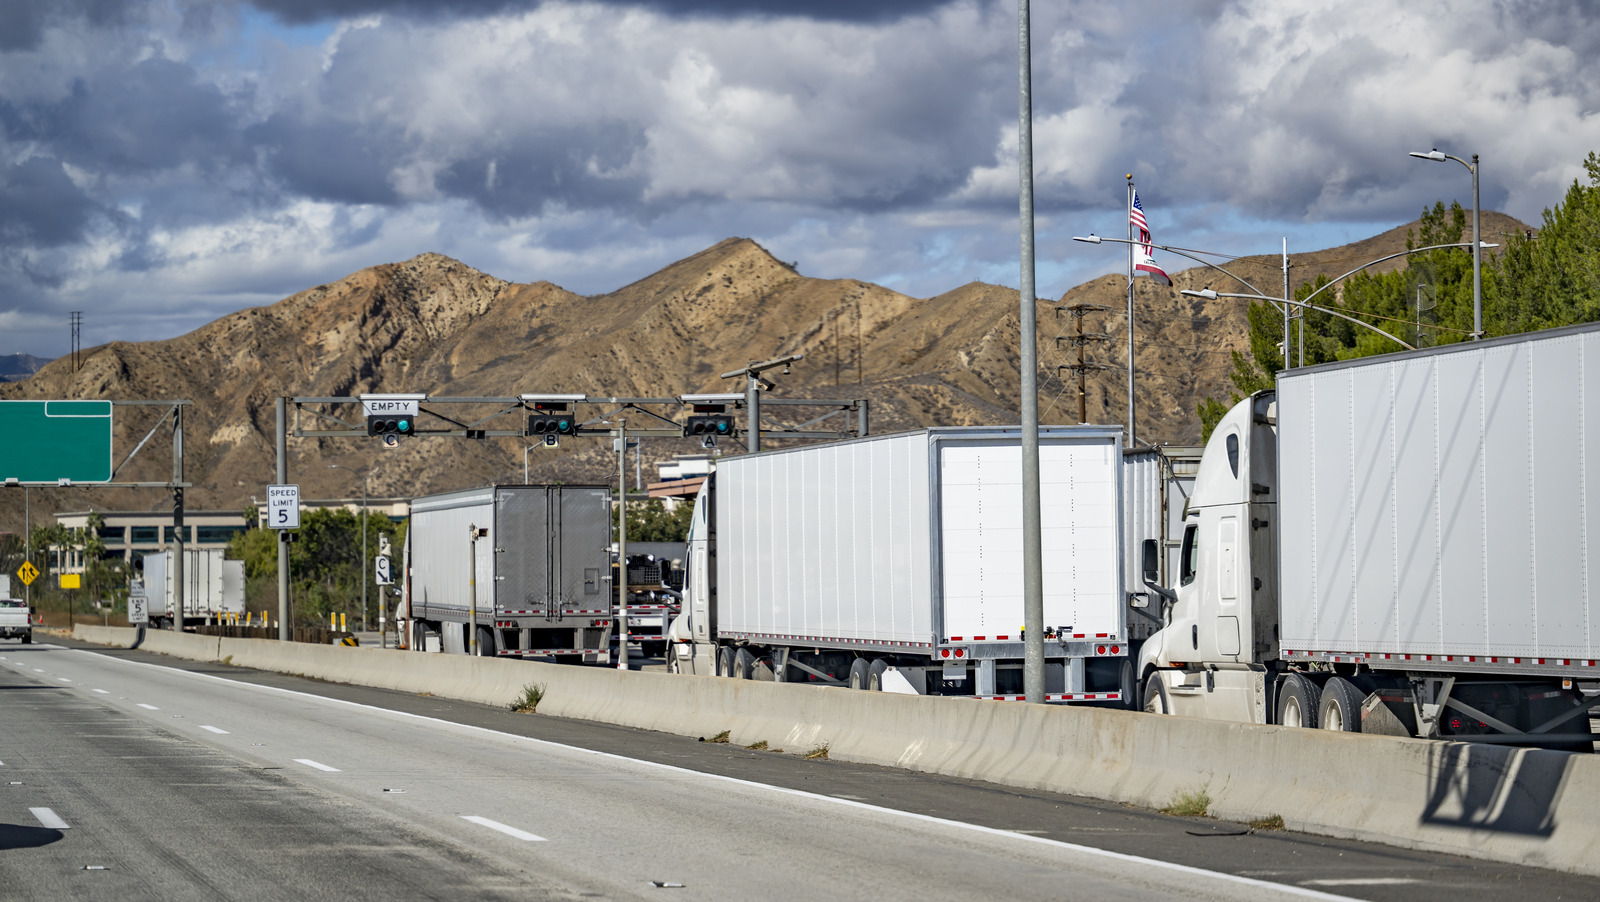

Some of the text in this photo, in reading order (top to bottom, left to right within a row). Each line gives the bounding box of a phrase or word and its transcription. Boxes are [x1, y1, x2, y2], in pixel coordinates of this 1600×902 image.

[371, 402, 410, 411] EMPTY
[386, 434, 395, 446] C
[546, 434, 556, 446] B
[705, 435, 715, 446] A
[270, 489, 297, 497] SPEED
[272, 499, 294, 507] LIMIT
[278, 509, 288, 523] 5
[378, 558, 386, 570] C
[135, 604, 142, 613] 5
